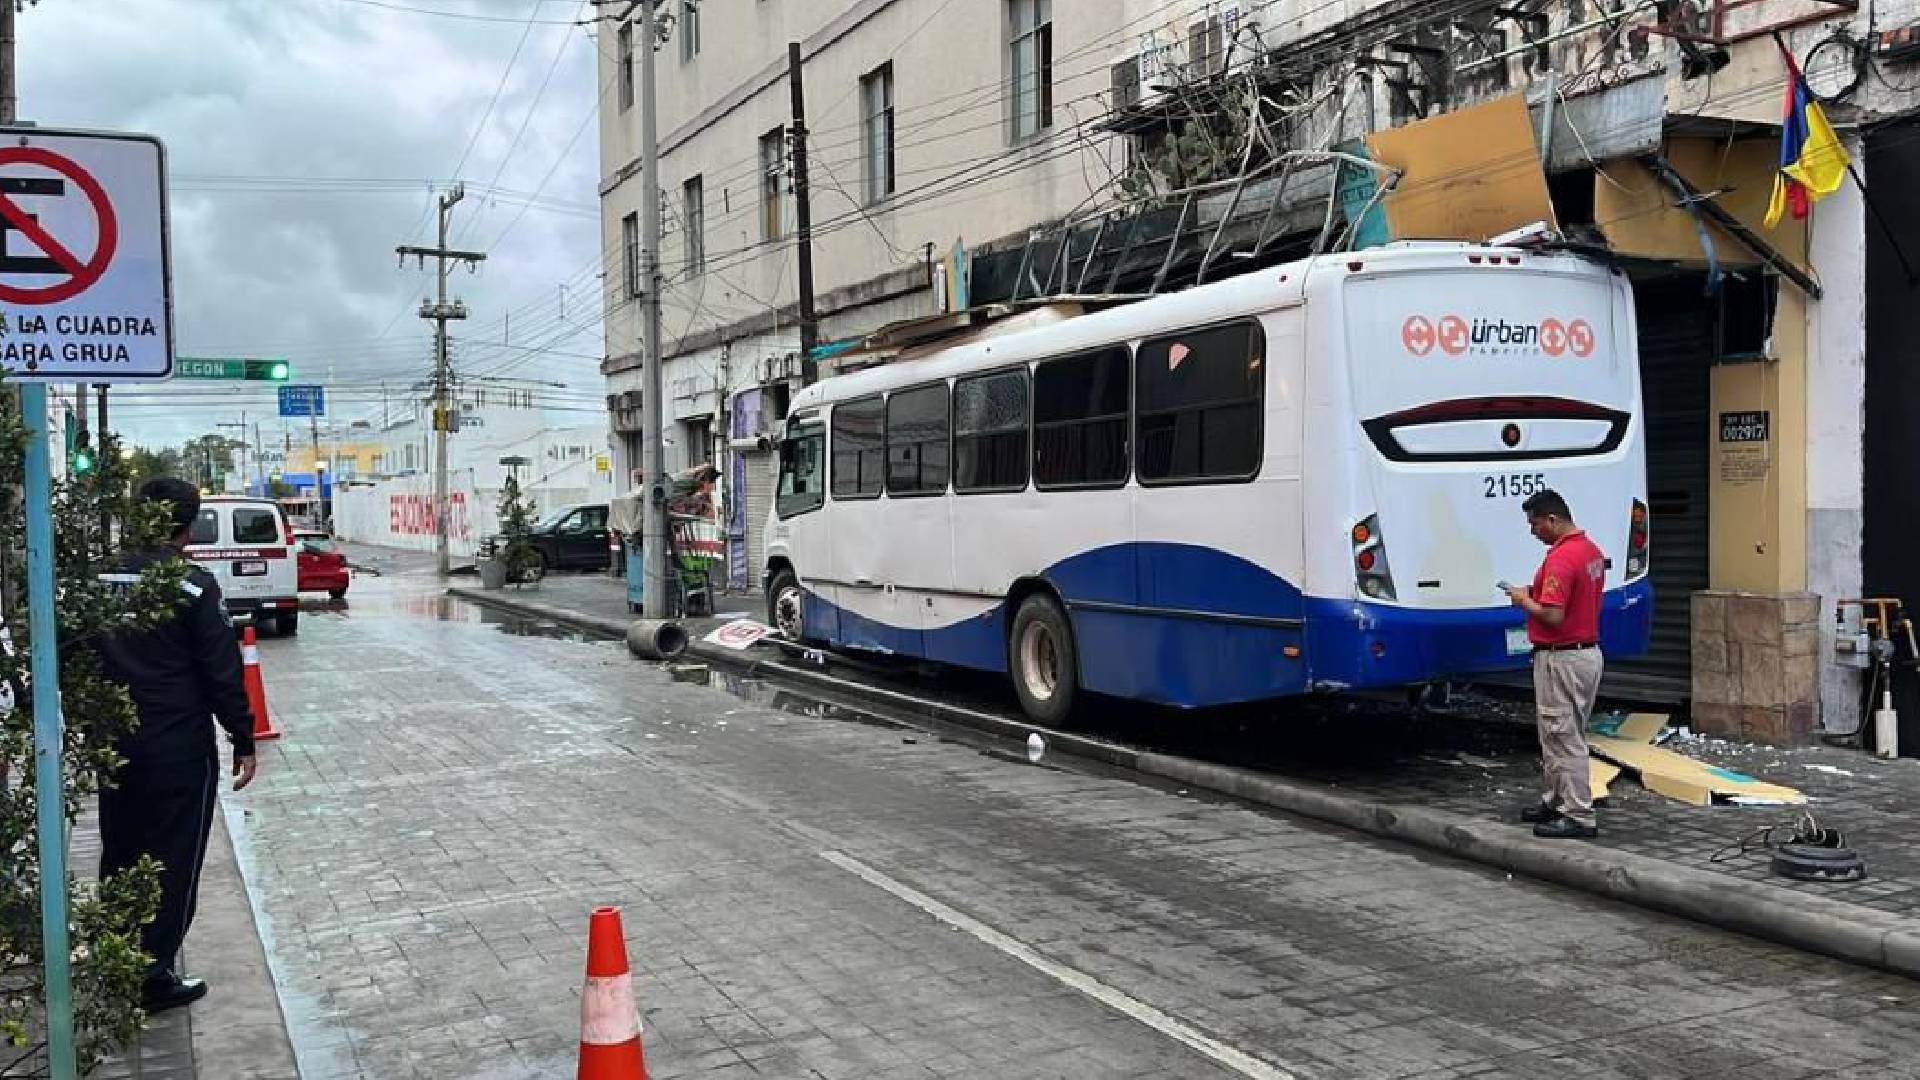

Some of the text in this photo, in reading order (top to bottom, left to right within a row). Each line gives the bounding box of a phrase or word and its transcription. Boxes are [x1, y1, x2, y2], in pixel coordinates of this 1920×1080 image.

[18, 315, 47, 334] LA
[56, 315, 157, 336] CUADRA
[0, 343, 130, 362] ARA GRUA
[1484, 473, 1546, 498] 21555
